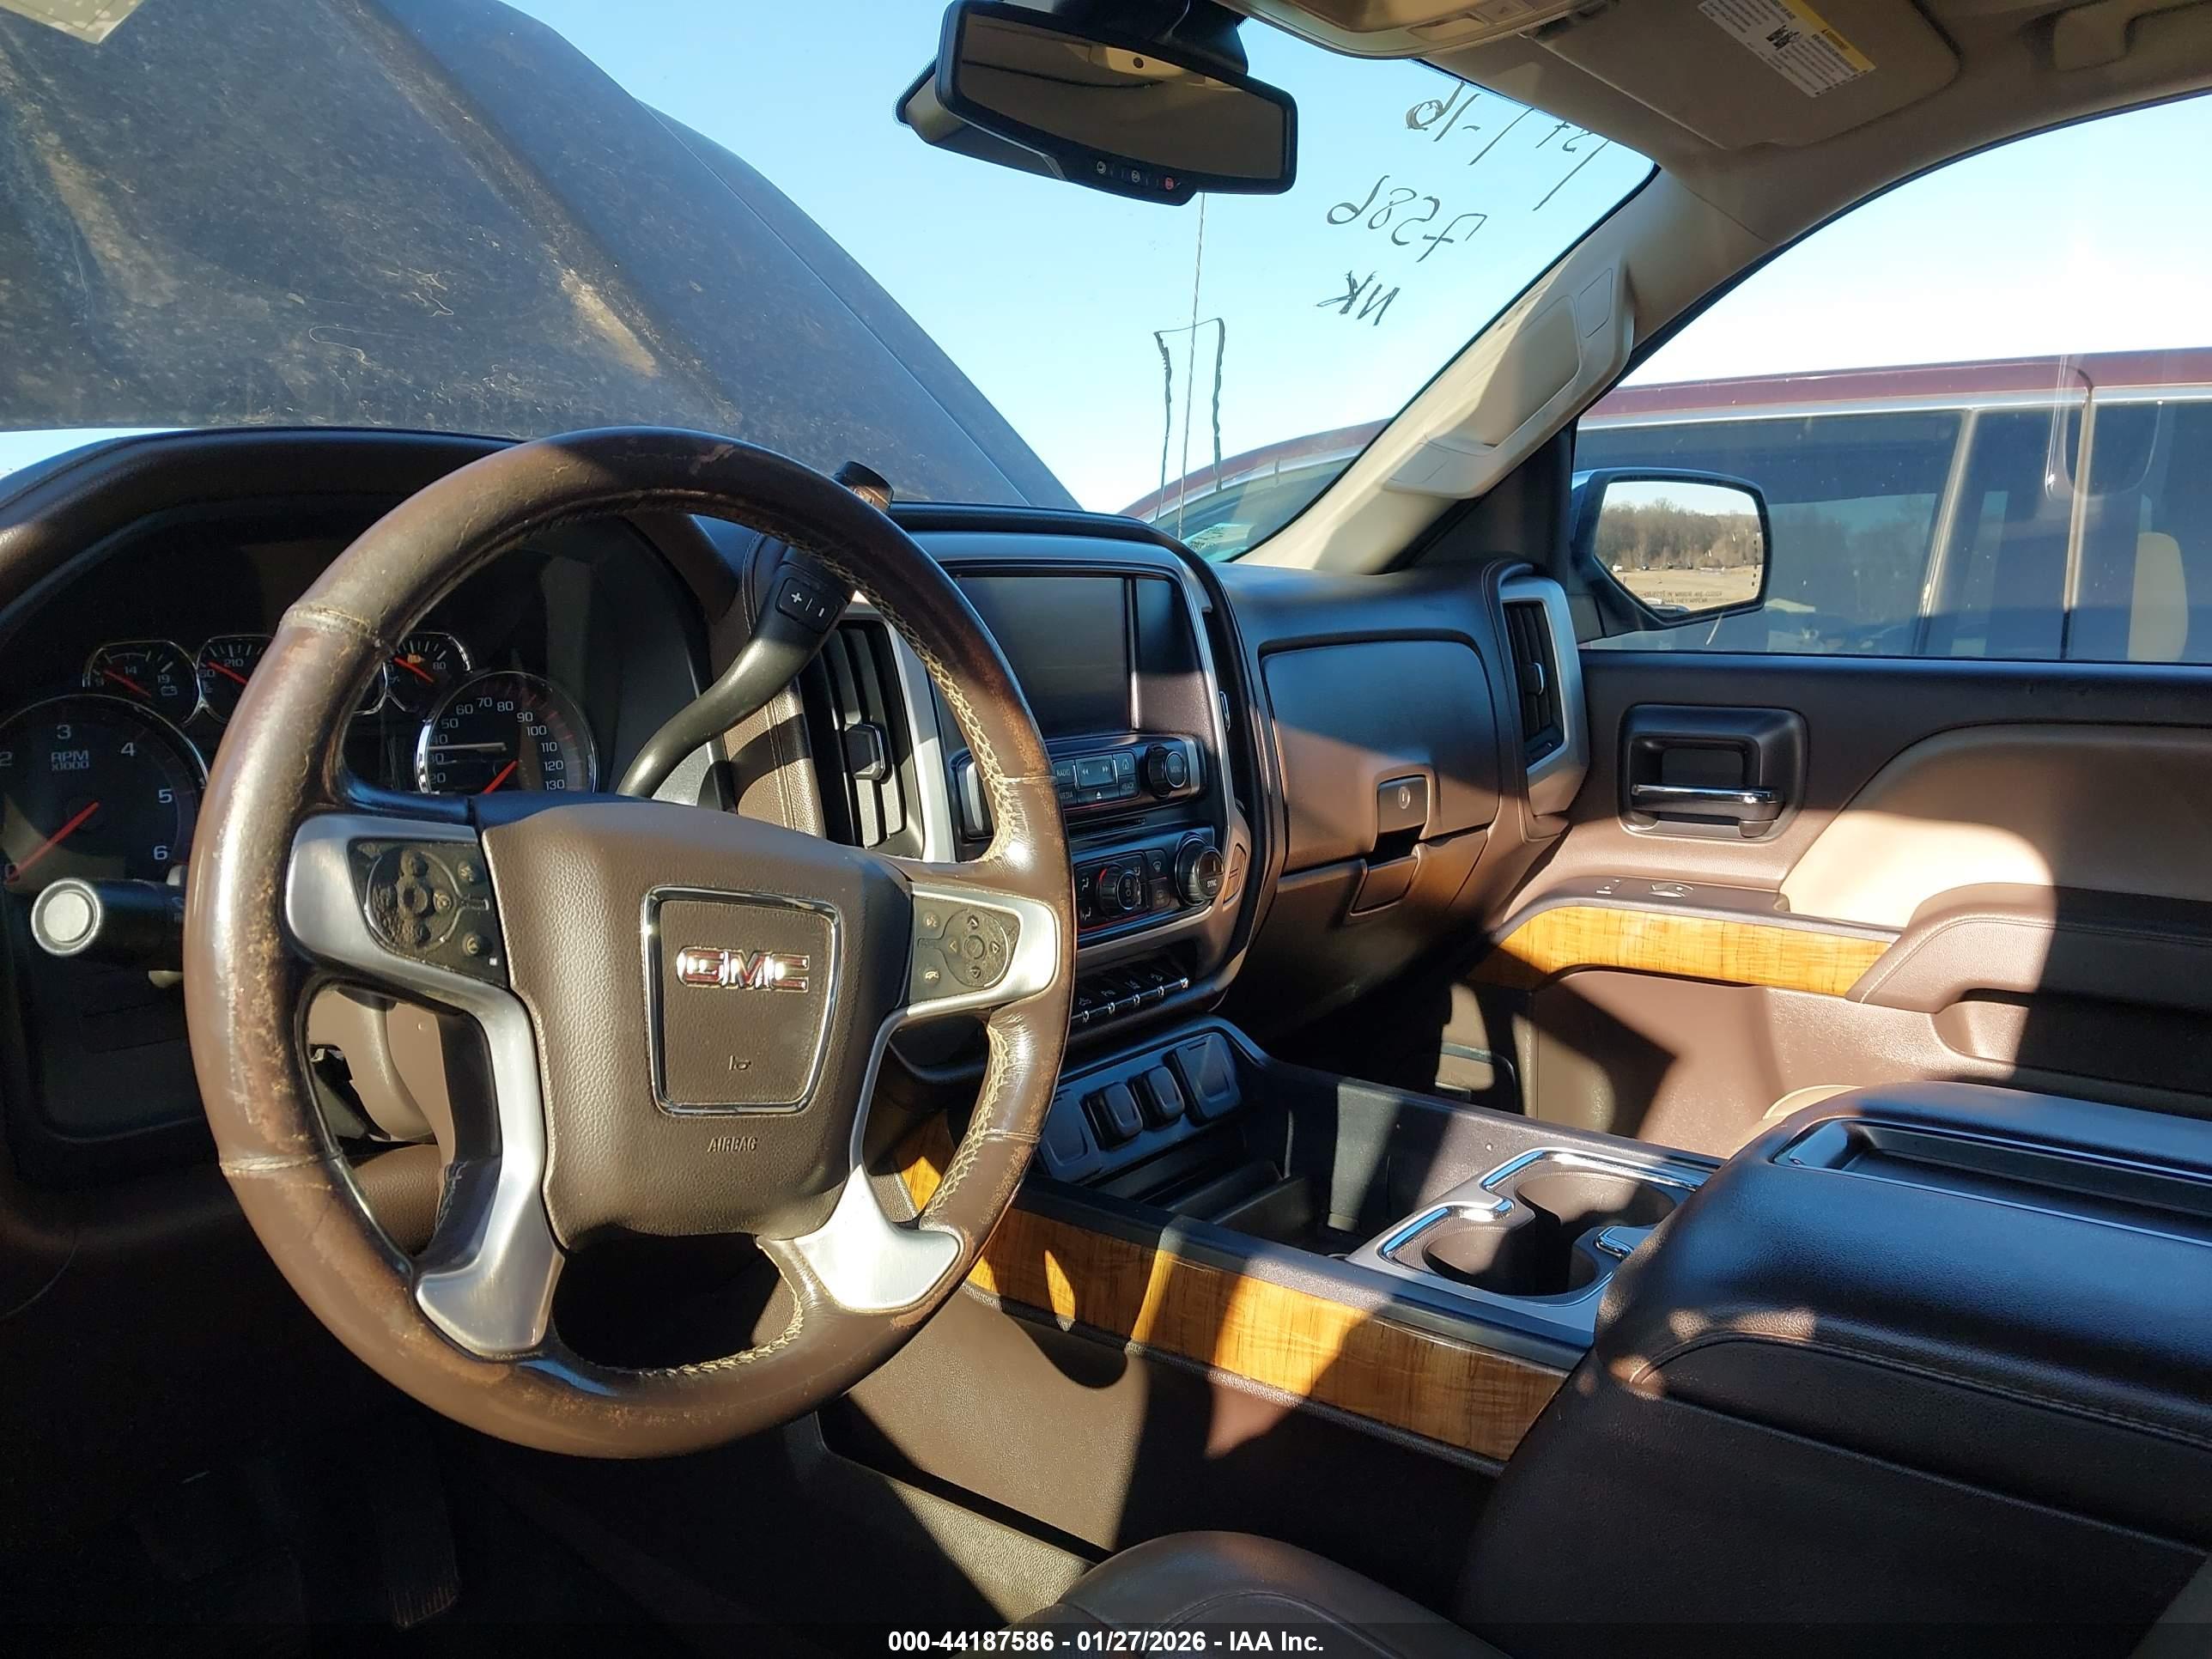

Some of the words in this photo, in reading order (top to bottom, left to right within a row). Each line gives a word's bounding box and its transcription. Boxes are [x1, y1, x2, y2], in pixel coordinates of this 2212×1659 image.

[432, 660, 447, 671] 80
[477, 696, 493, 708] 70
[496, 701, 514, 713] 80
[455, 703, 474, 715] 60
[515, 711, 534, 723] 90
[441, 718, 459, 729] 50
[56, 724, 71, 740] 3
[526, 725, 548, 737] 100
[120, 742, 137, 757] 4
[541, 742, 557, 752] 110
[0, 751, 14, 767] 2
[51, 750, 90, 763] RPM
[544, 760, 564, 771] 120
[544, 780, 565, 791] 130
[158, 788, 173, 804] 5
[153, 845, 168, 860] 6
[677, 946, 811, 993] GMC
[707, 1137, 758, 1153] AIRBAG
